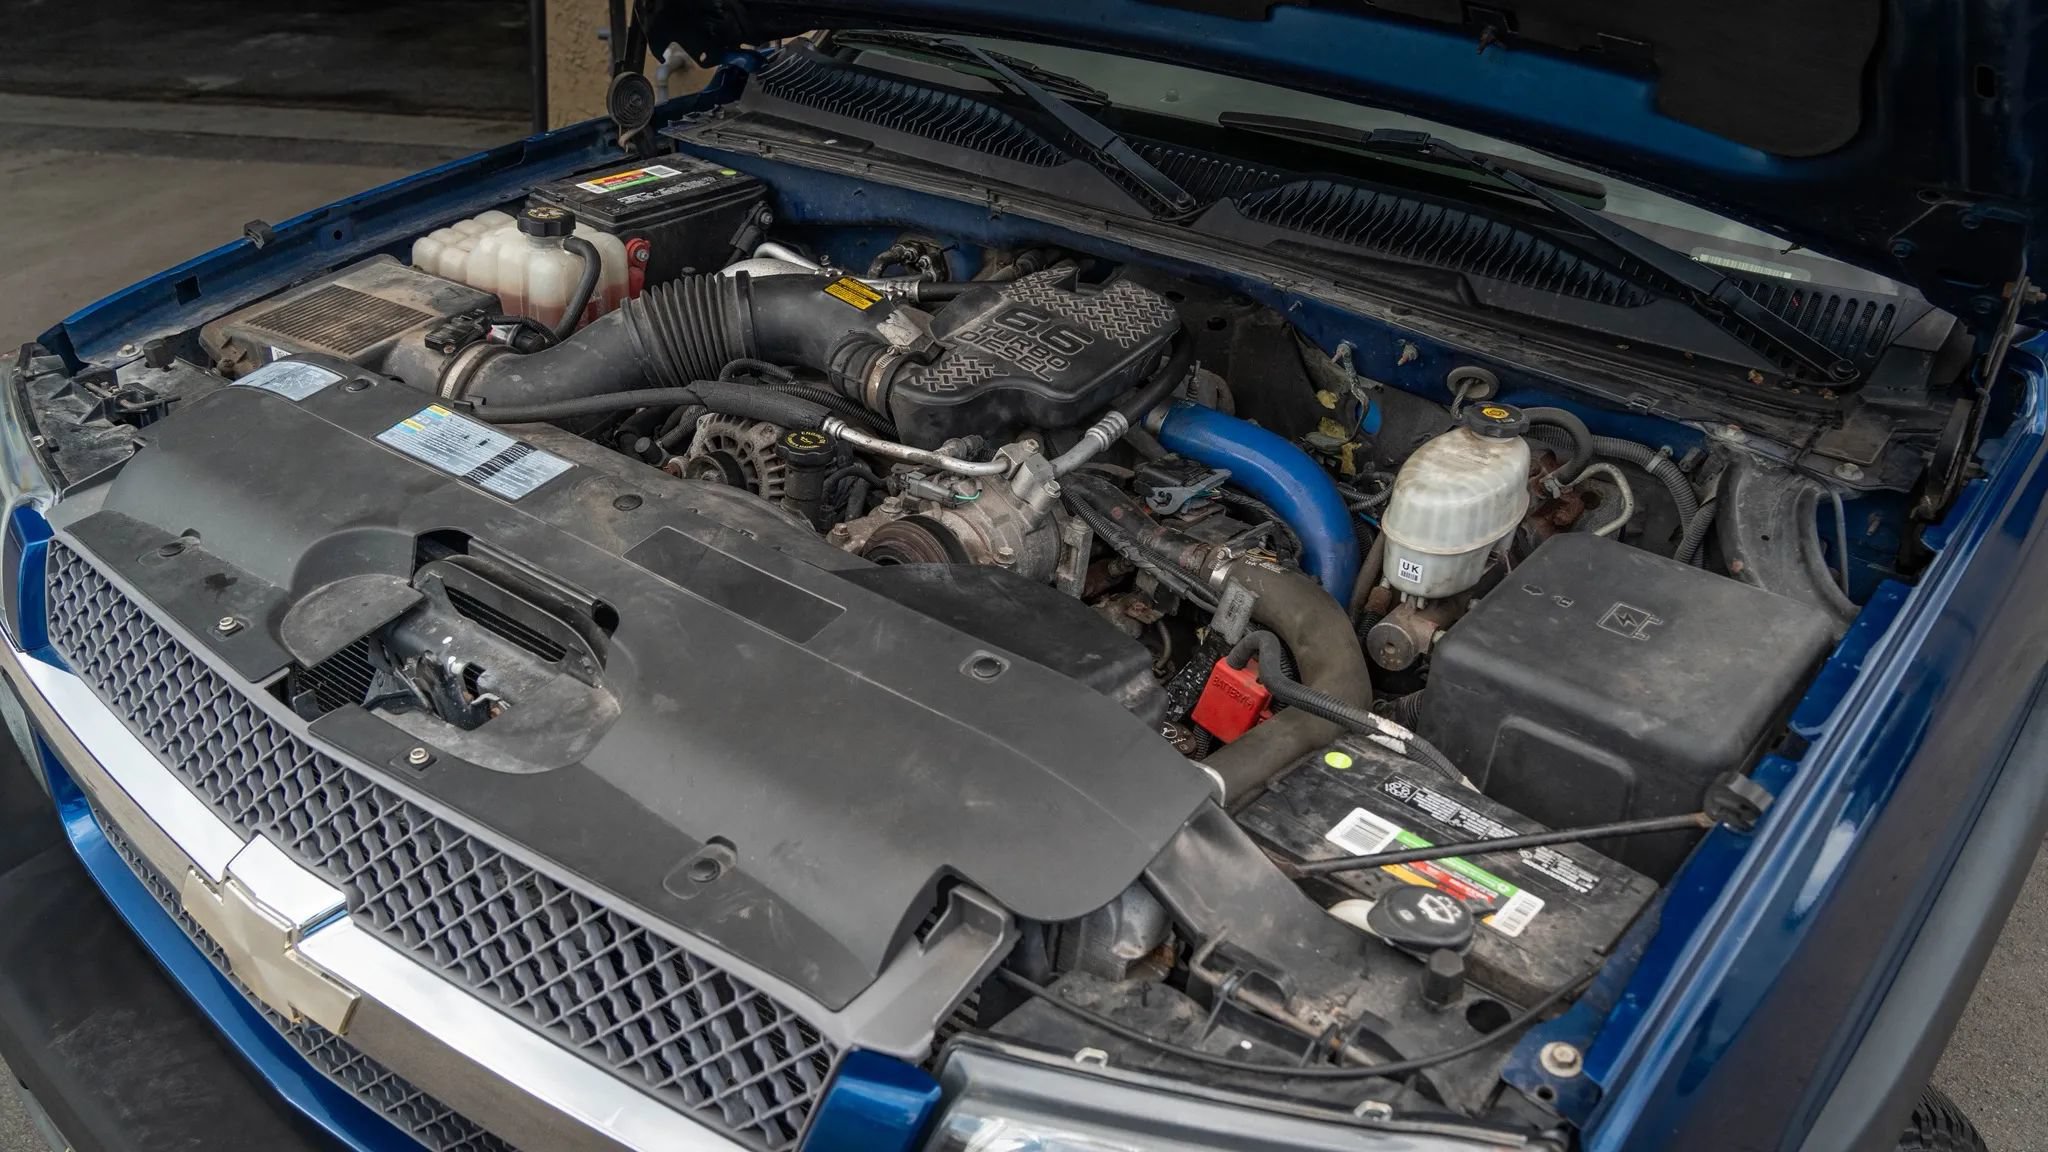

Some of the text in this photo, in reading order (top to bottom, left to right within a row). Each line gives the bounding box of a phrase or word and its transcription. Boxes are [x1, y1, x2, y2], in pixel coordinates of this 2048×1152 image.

[979, 325, 1071, 371] TURBO
[993, 308, 1094, 355] 6.6
[955, 330, 1054, 382] DIESEL
[1402, 561, 1419, 574] UK
